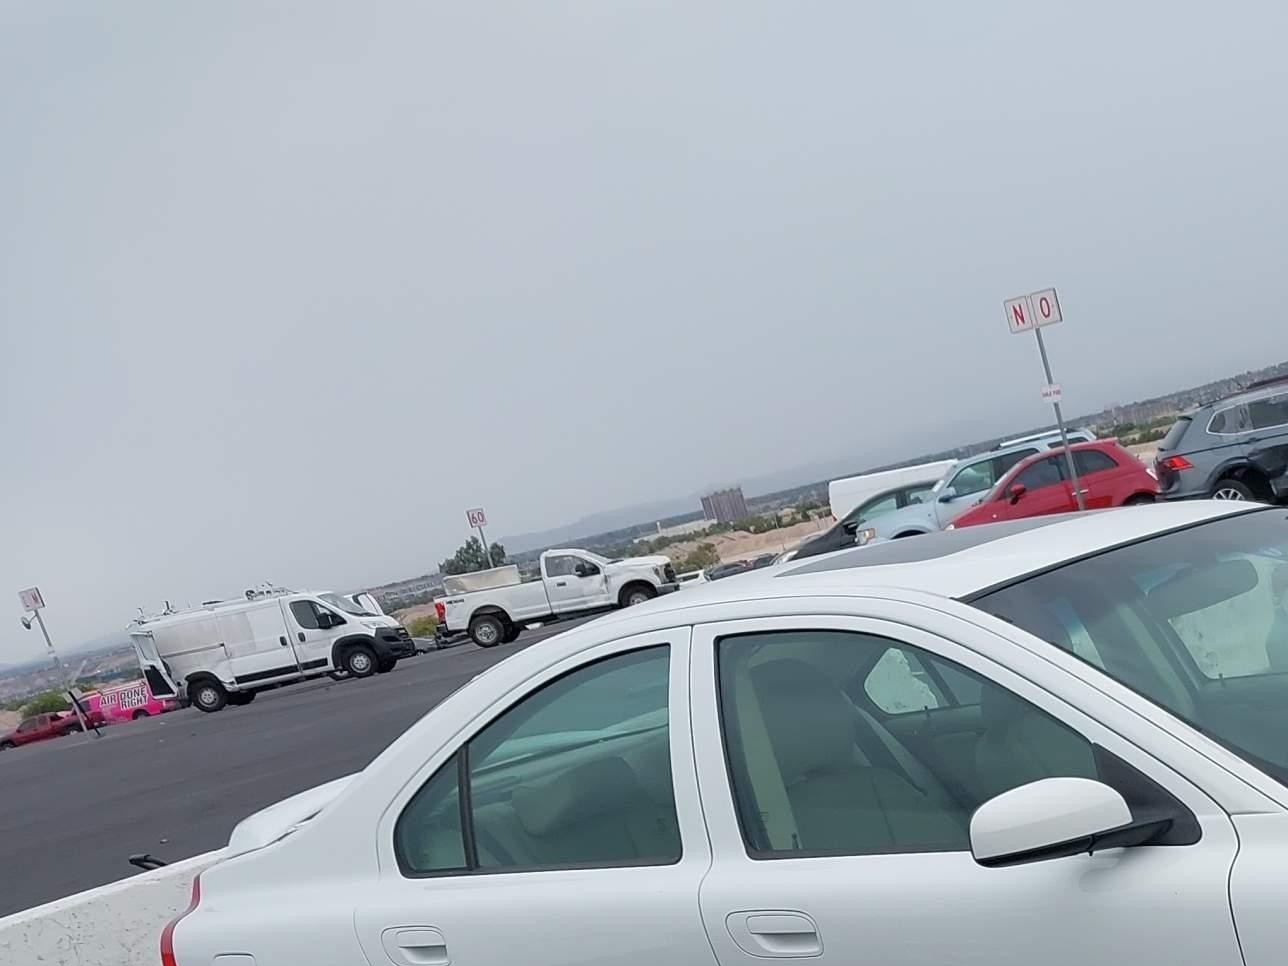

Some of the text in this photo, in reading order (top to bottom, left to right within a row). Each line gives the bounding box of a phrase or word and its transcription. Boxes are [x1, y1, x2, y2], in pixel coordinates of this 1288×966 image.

[101, 686, 146, 706] AIR DONE
[121, 696, 148, 709] RIGHT
